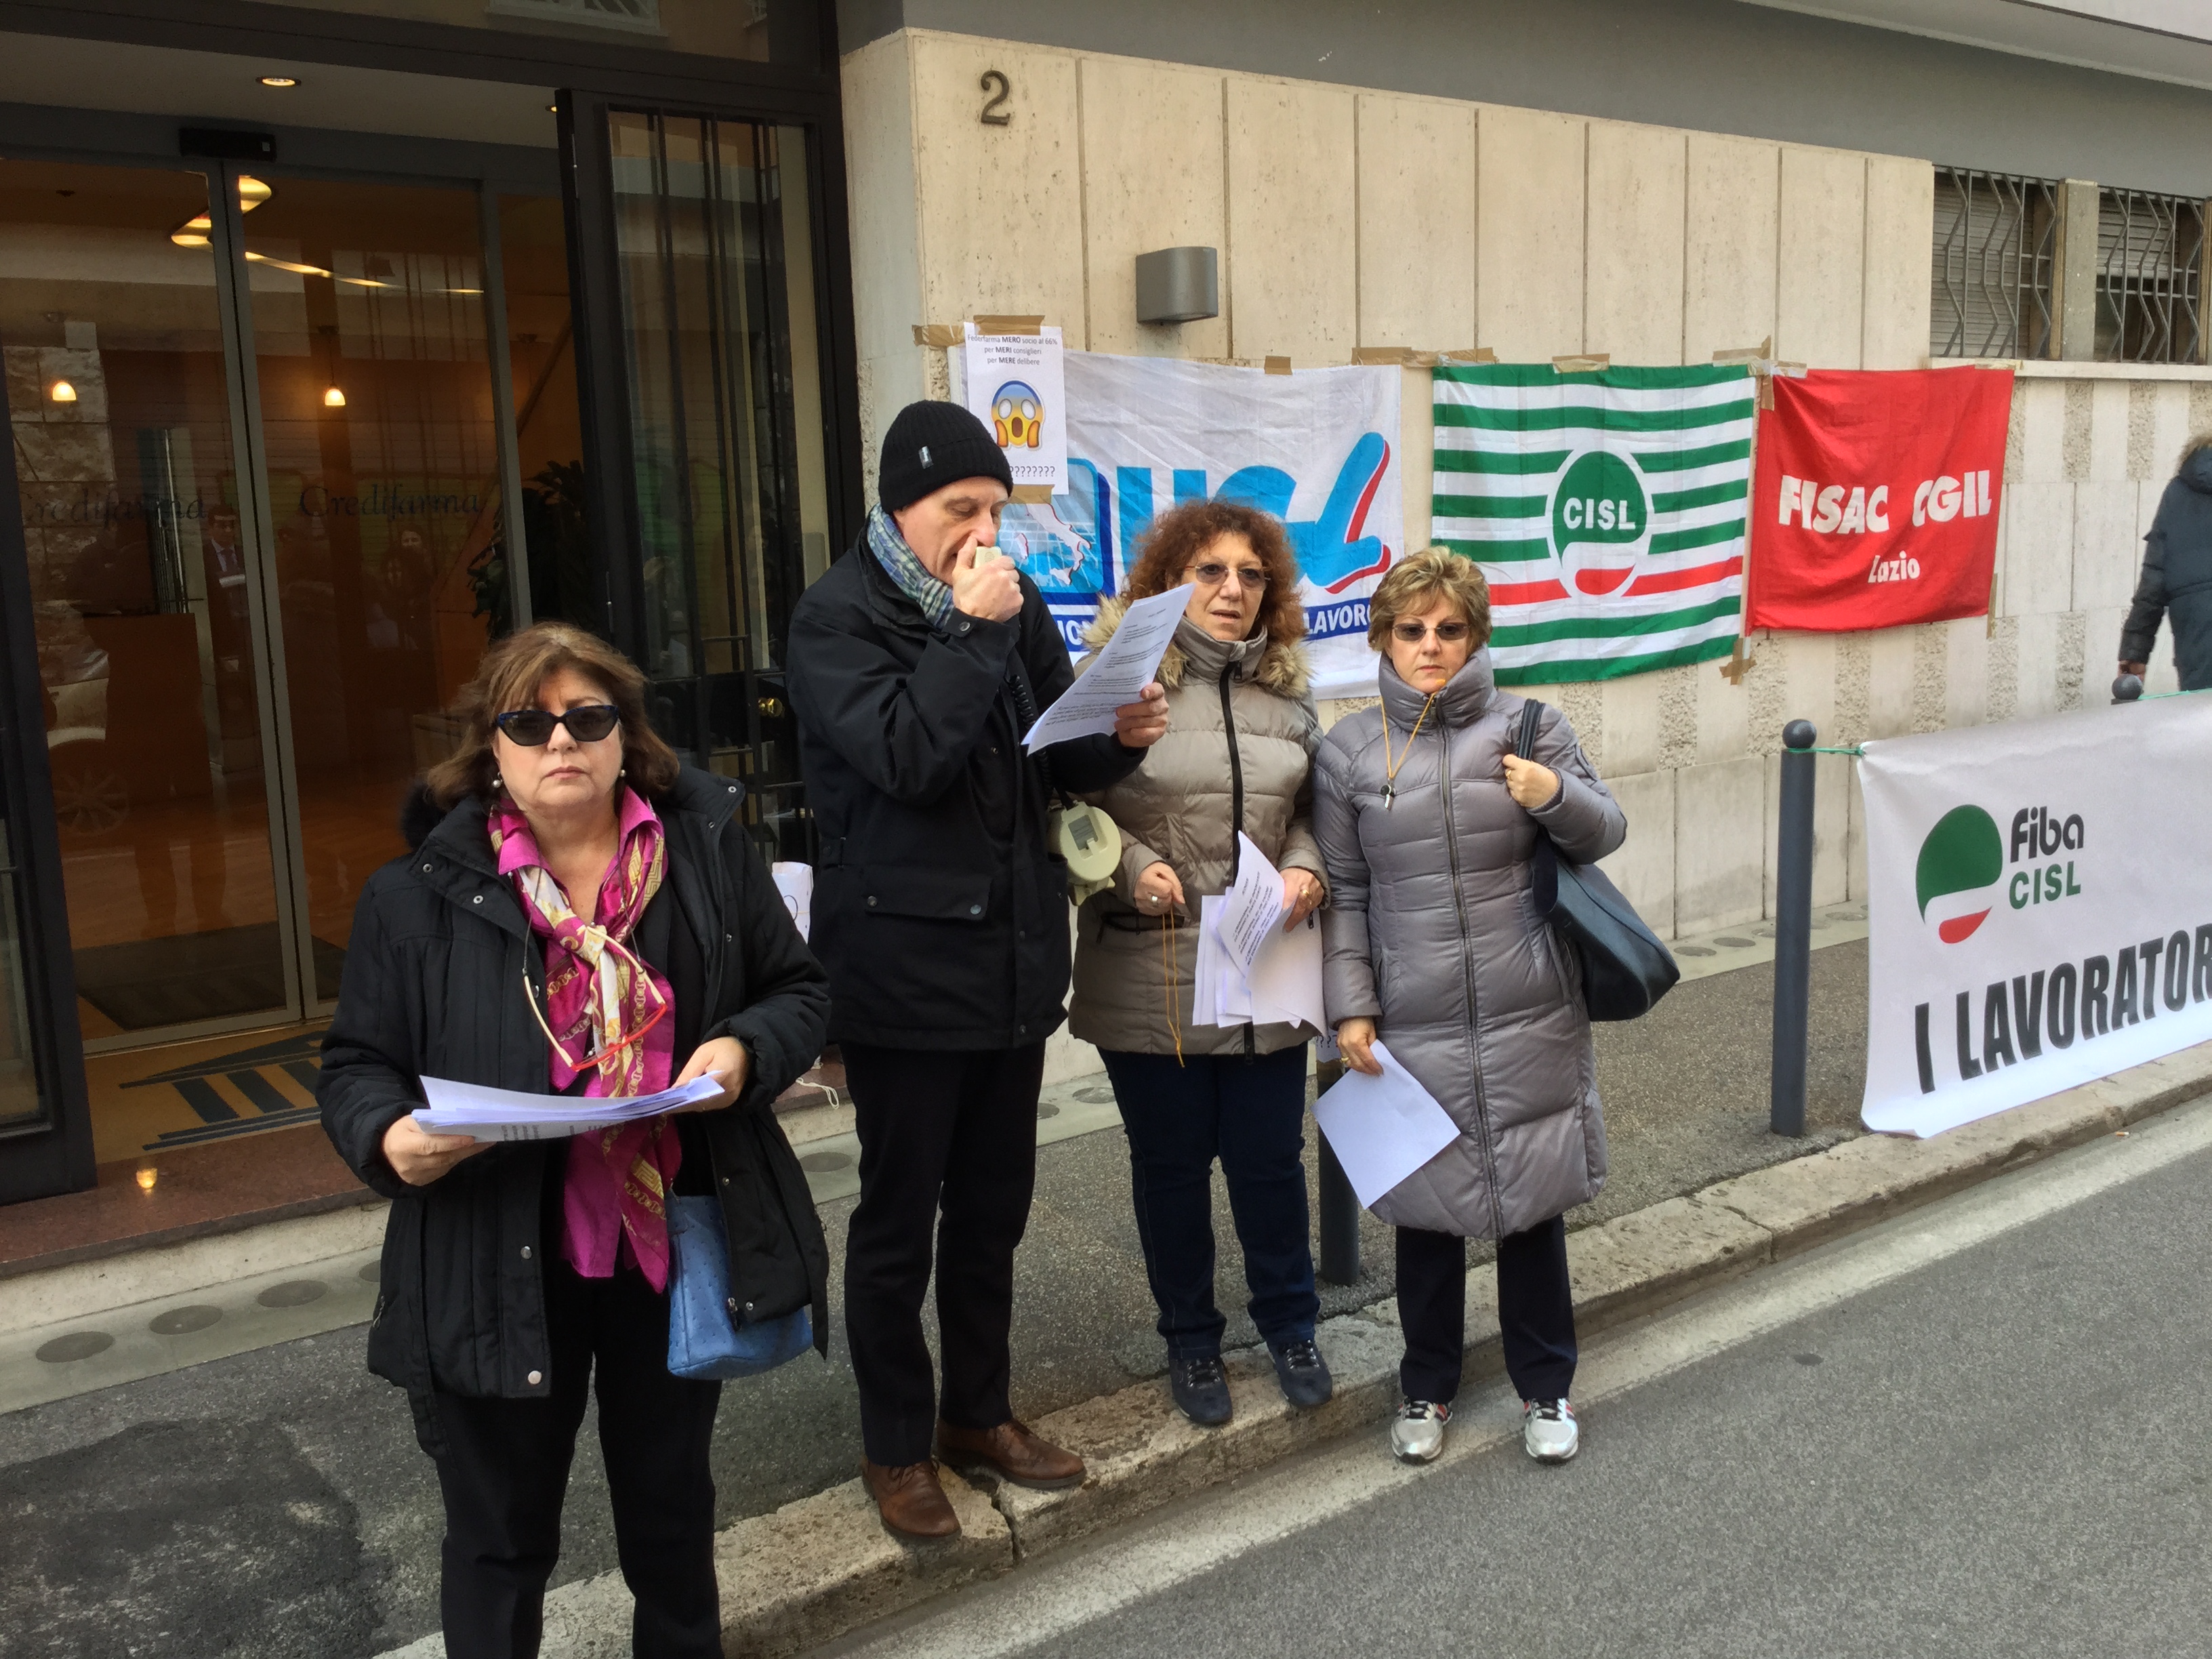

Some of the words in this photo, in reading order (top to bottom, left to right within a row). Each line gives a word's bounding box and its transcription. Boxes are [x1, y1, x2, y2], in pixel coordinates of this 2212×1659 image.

[981, 70, 1010, 126] 2
[1013, 348, 1042, 356] consiglieri
[300, 484, 479, 520] Credifarma
[1563, 497, 1636, 531] CISL
[1778, 474, 1889, 535] FISAC
[1912, 470, 1992, 528] CGIL
[1868, 550, 1921, 583] Lazio
[1303, 603, 1370, 635] LAVOR
[2009, 860, 2081, 910] CISL
[1914, 1002, 1936, 1095] I
